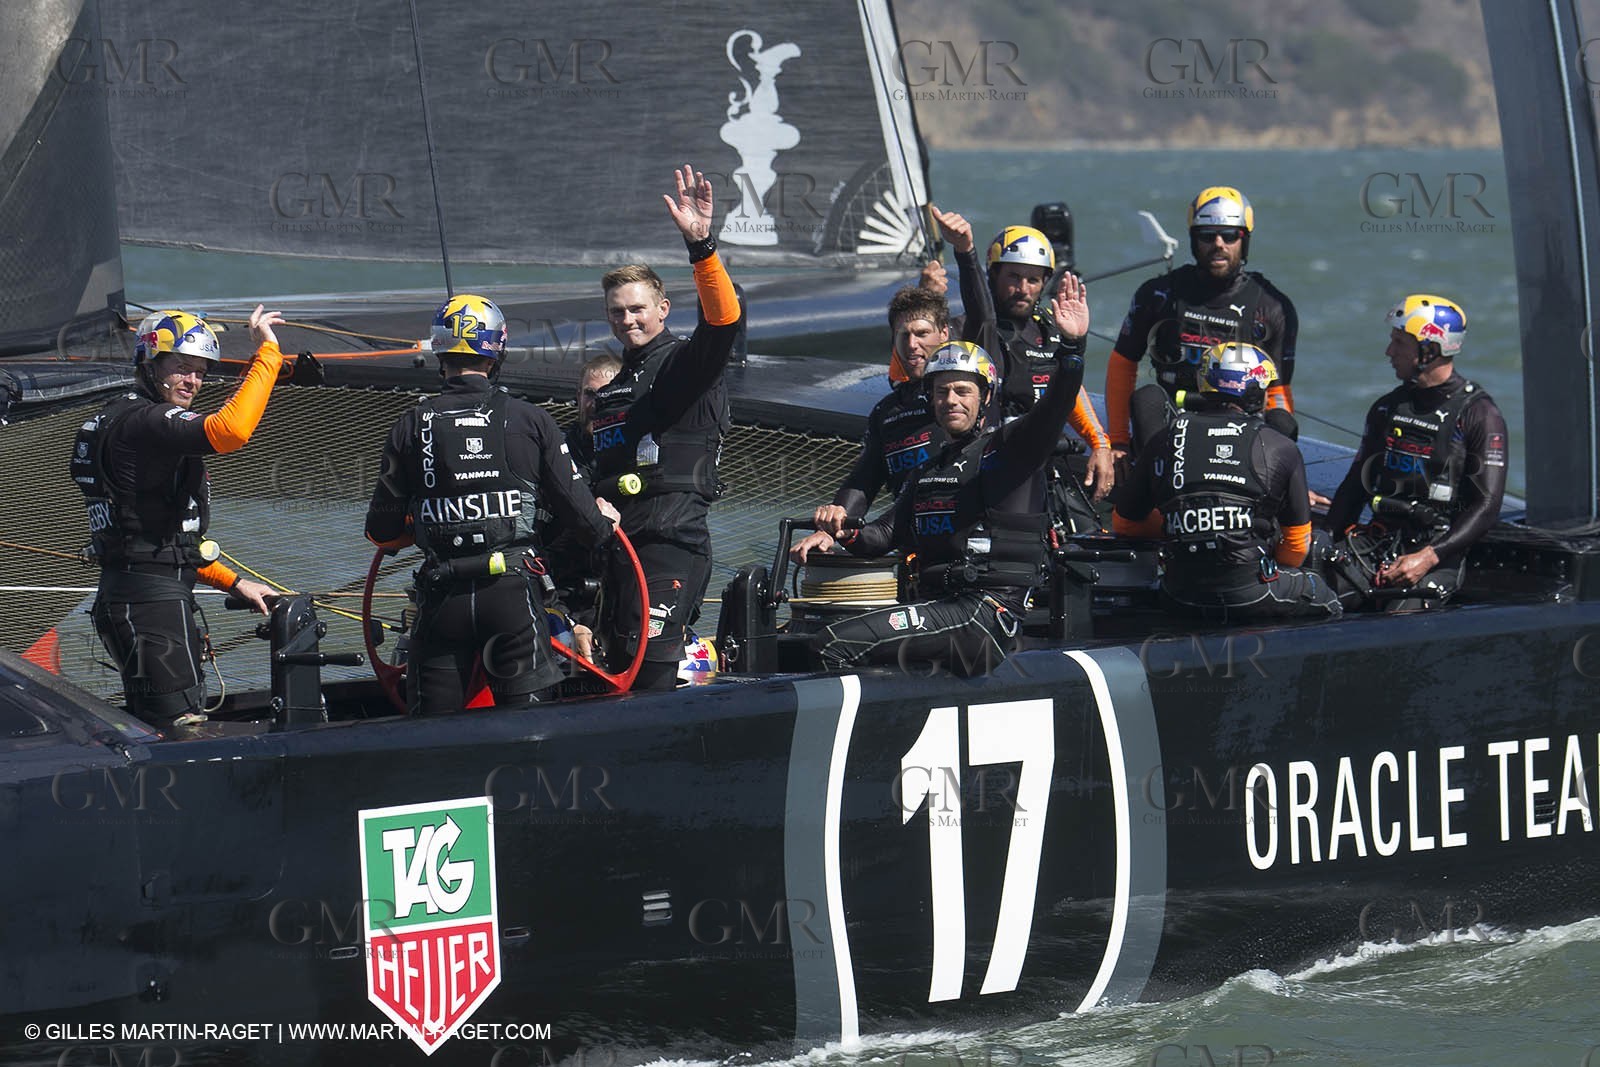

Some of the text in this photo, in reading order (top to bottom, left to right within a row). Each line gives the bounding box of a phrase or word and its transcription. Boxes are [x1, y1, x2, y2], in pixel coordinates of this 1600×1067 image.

[452, 314, 478, 340] 12
[1208, 316, 1225, 325] TEAM
[422, 411, 436, 489] ORACLE
[595, 427, 626, 452] USA
[1173, 418, 1189, 490] ORACLE
[454, 470, 500, 480] YANMAR
[889, 447, 930, 473] USA
[1203, 473, 1246, 485] YANMAR
[421, 489, 522, 523] AINSLIE
[920, 514, 955, 535] USA
[1245, 747, 1468, 870] ORACLE
[901, 698, 1055, 1003] 17
[382, 813, 475, 919] TAG
[376, 931, 492, 1031] HEUER
